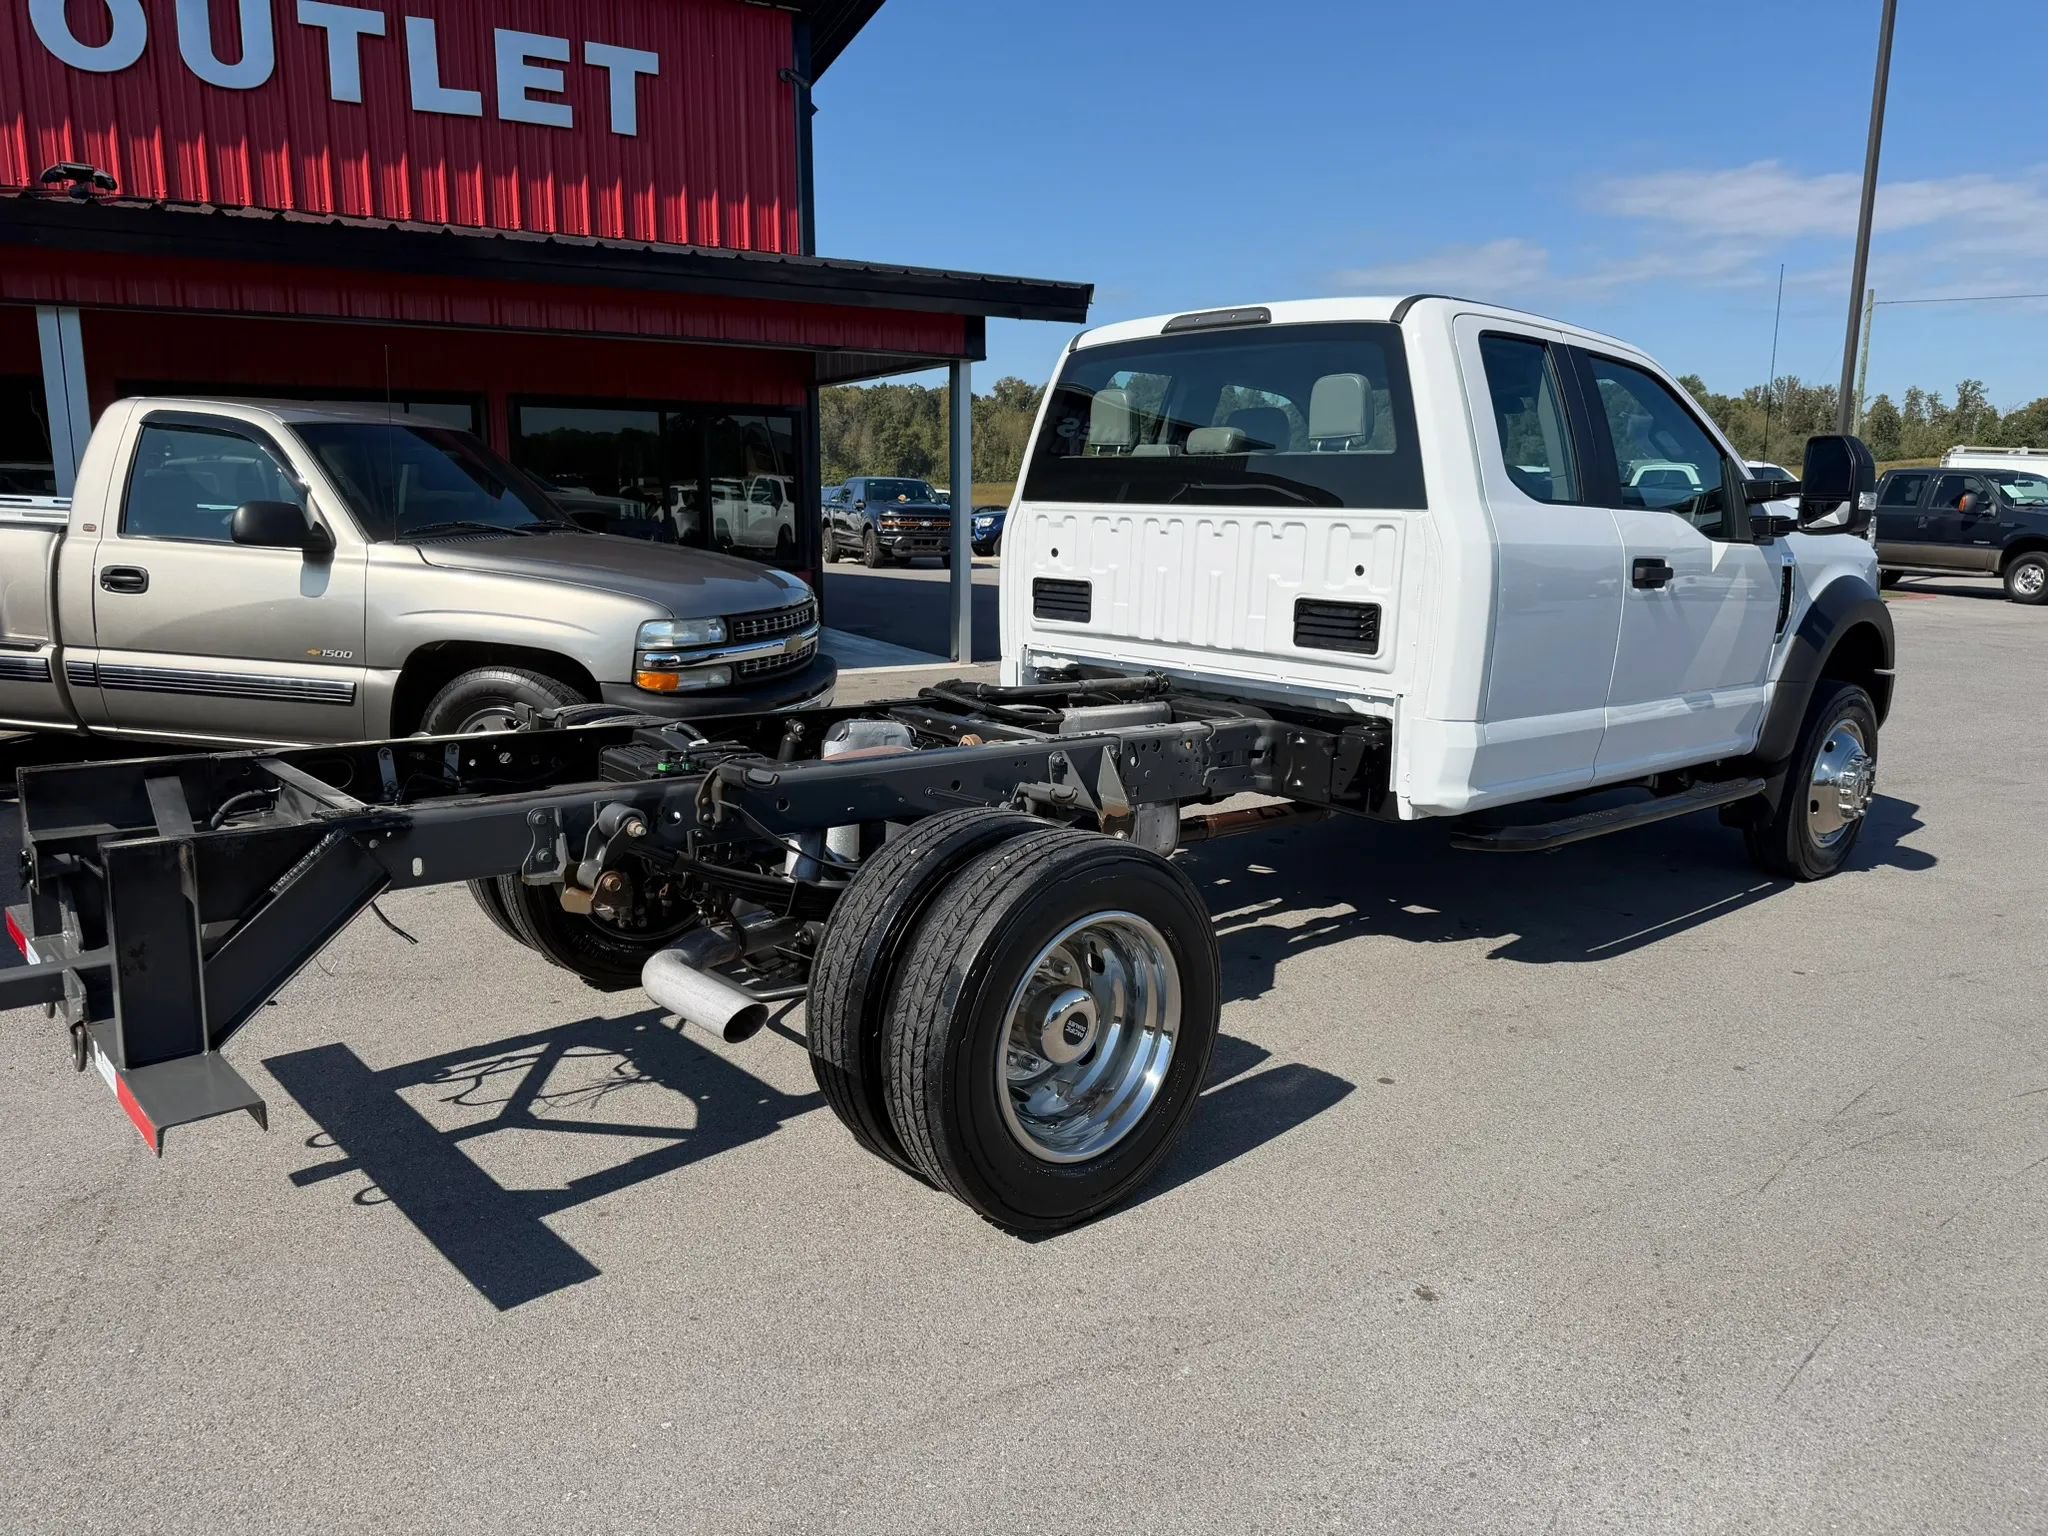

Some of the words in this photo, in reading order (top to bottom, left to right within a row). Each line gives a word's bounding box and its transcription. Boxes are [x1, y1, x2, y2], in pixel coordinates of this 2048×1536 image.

[28, 0, 659, 137] OUTLET
[321, 649, 353, 659] 1500
[1065, 1025, 1084, 1038] PACIFIC
